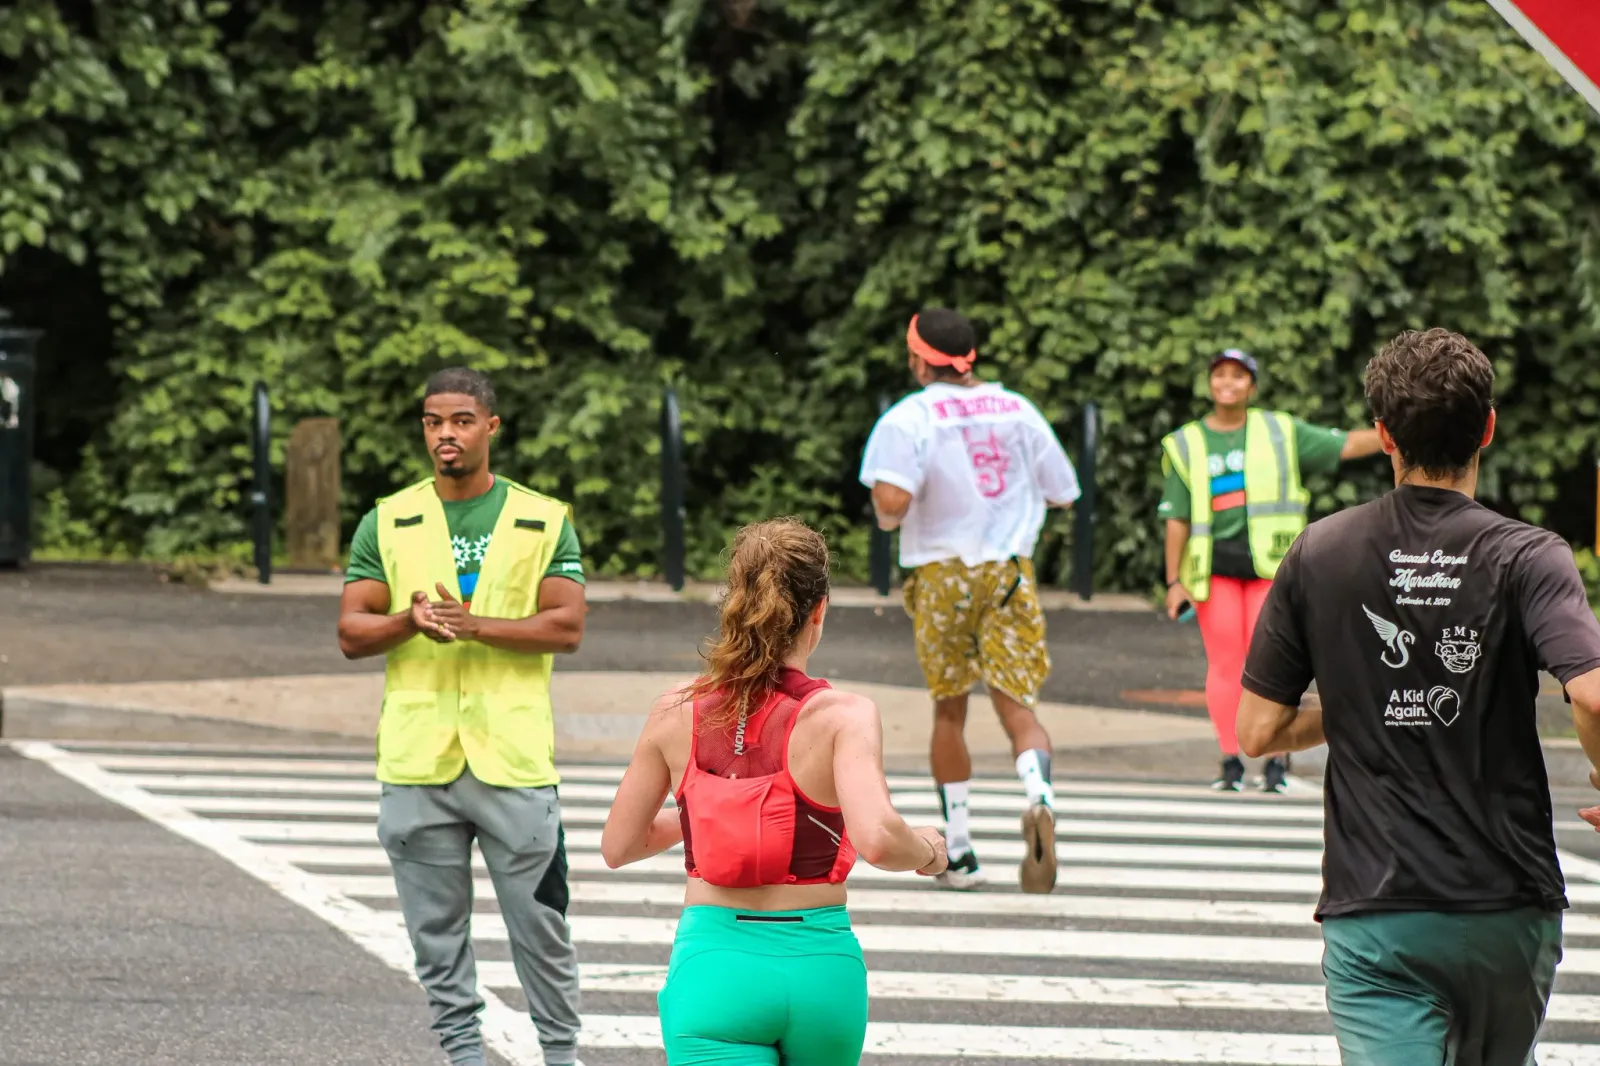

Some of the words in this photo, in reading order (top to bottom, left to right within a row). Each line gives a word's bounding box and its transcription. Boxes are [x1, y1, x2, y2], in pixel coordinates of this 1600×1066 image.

[1389, 549, 1430, 564] Cascade
[1430, 549, 1468, 568] Express
[1389, 568, 1462, 592] Marathon
[1433, 597, 1451, 606] 2019
[1442, 625, 1478, 641] EMP
[1389, 689, 1401, 703] A
[1403, 689, 1424, 703] Kid
[1384, 704, 1428, 720] Again.
